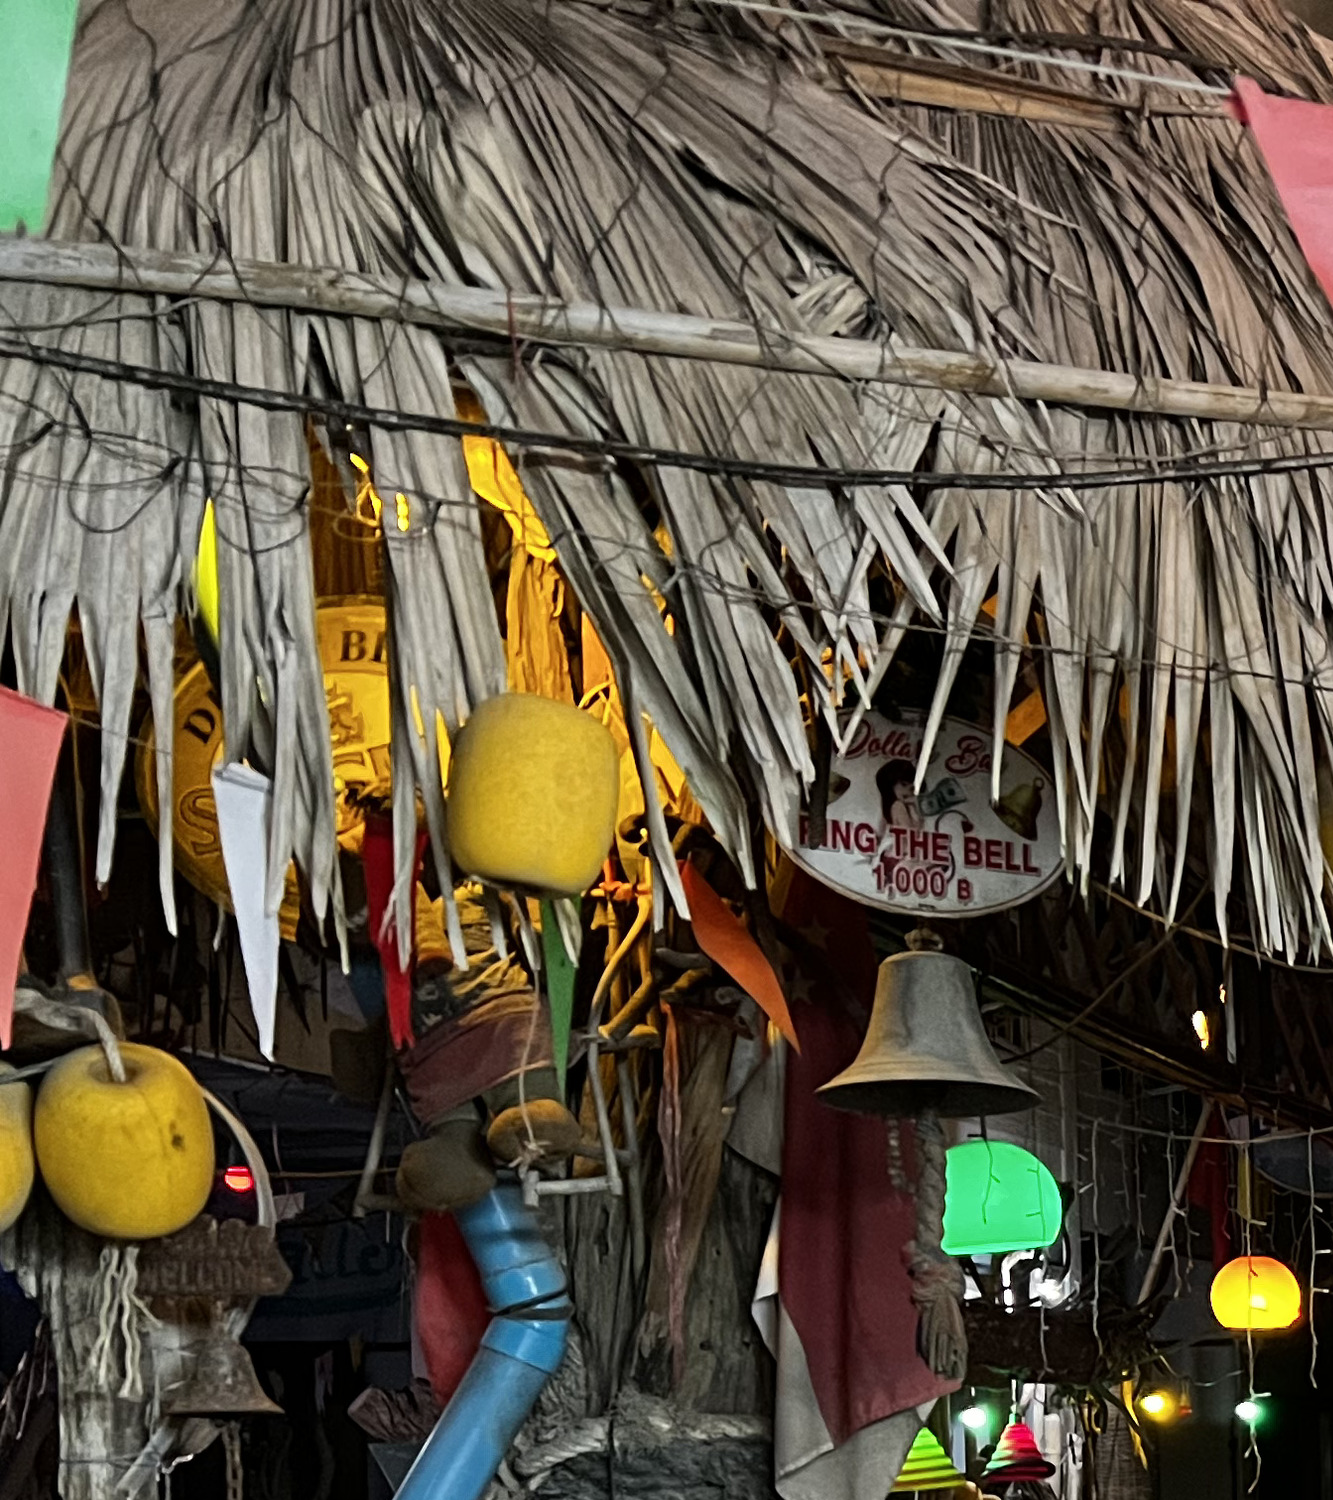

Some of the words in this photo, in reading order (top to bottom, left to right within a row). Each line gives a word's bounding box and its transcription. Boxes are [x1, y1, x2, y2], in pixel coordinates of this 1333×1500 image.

[836, 717, 935, 763] Dolla
[945, 735, 1007, 776] Ba
[890, 827, 950, 862] THE
[963, 837, 1040, 875] BELL
[875, 866, 945, 899] 1,000
